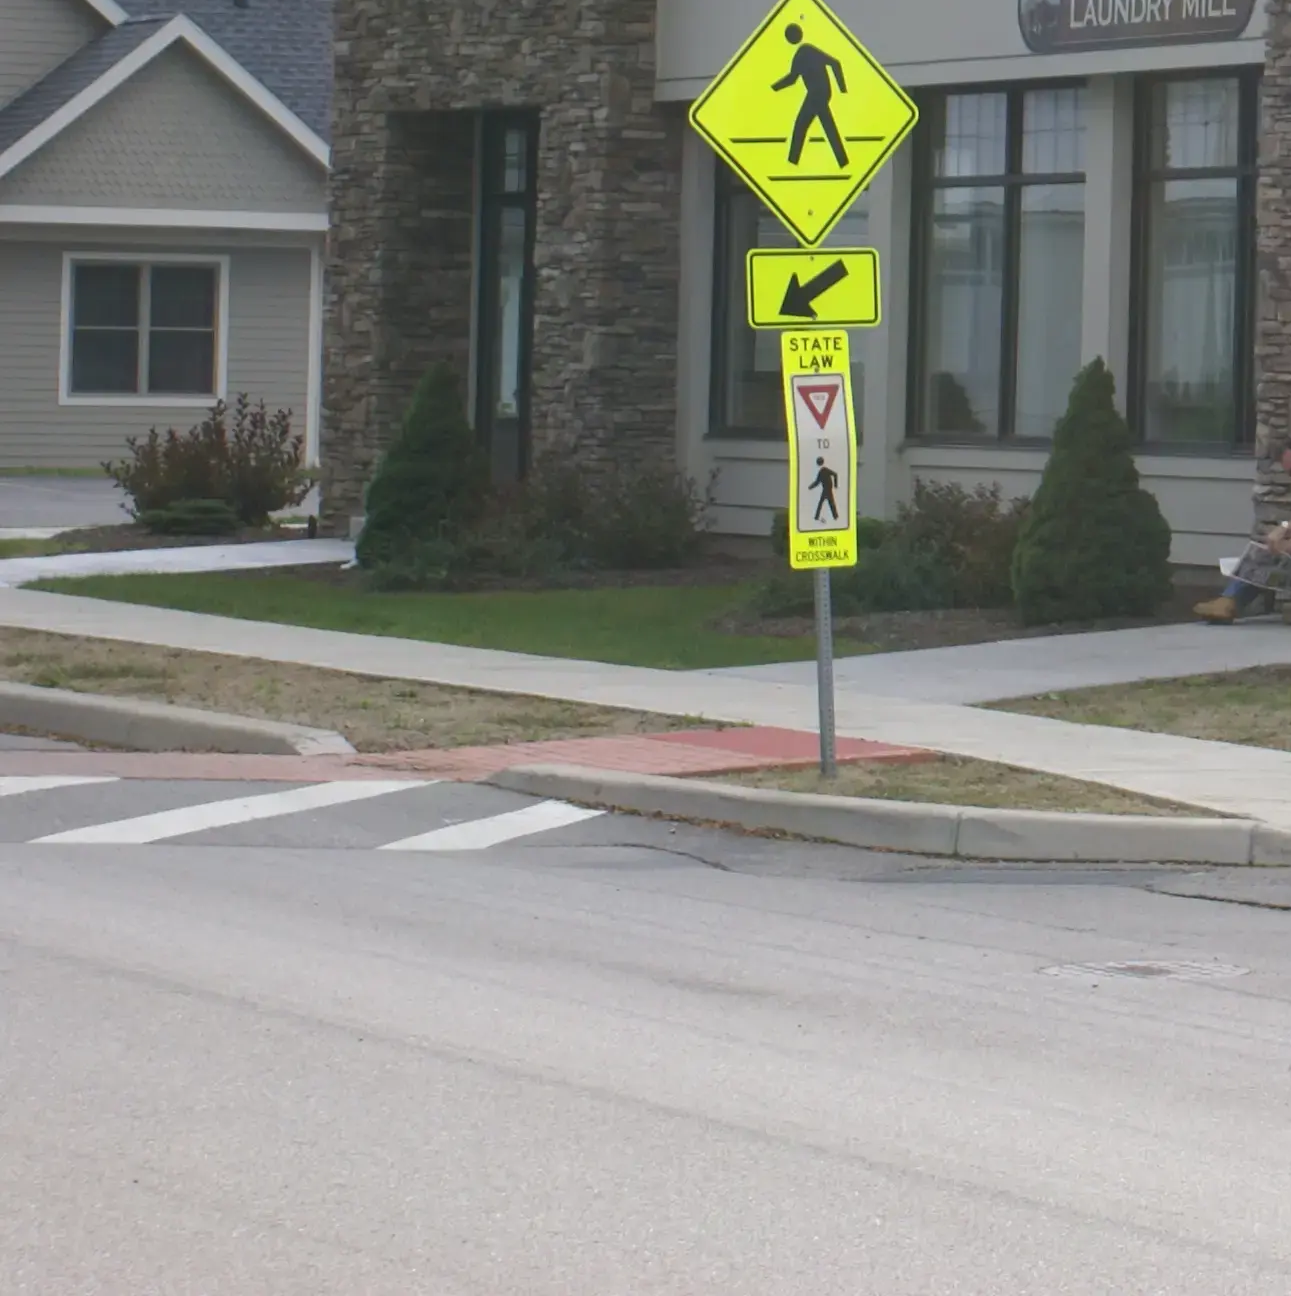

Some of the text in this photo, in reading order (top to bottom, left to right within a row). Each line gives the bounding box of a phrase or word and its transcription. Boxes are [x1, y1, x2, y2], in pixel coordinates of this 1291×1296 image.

[789, 337, 843, 352] STATE
[799, 355, 834, 370] LAW
[817, 438, 830, 450] TO
[808, 536, 838, 547] WITHIN
[795, 550, 849, 563] CROSSWALK
